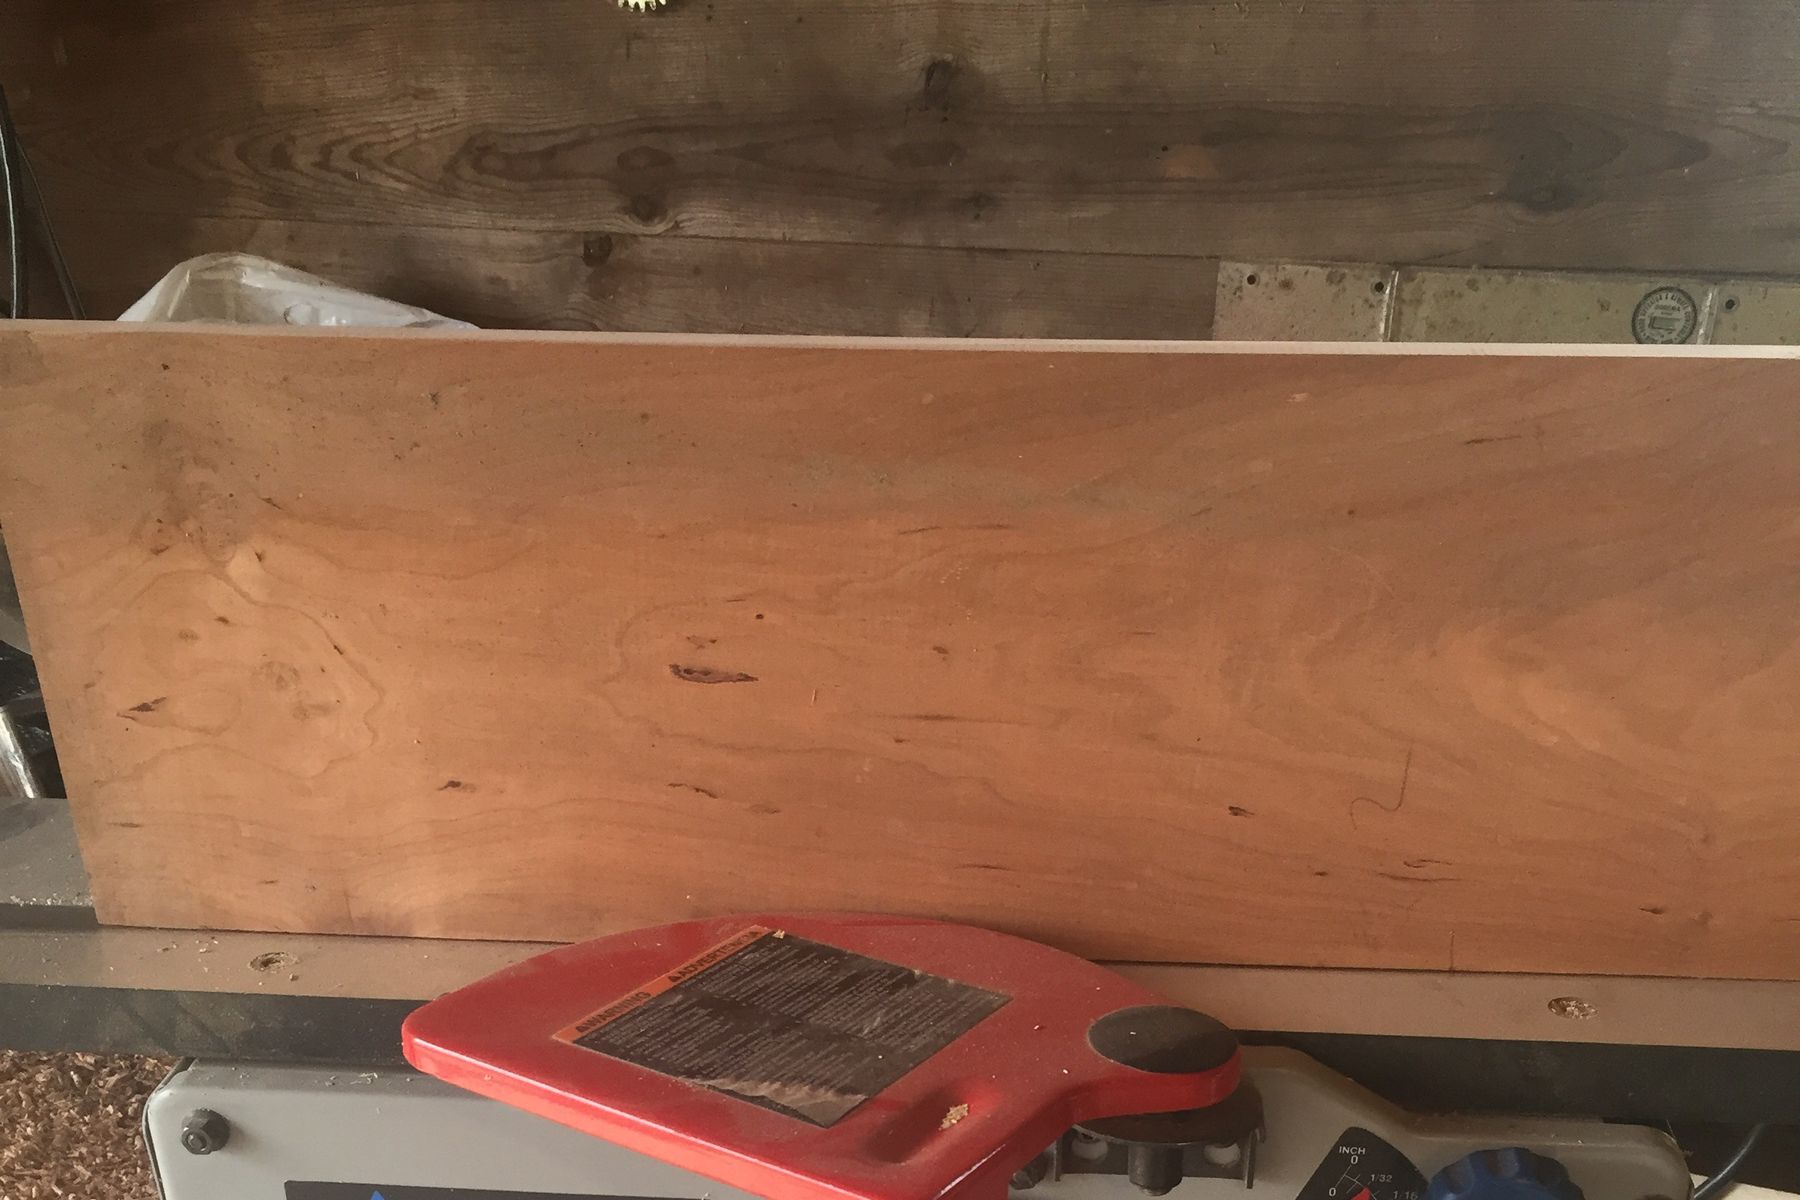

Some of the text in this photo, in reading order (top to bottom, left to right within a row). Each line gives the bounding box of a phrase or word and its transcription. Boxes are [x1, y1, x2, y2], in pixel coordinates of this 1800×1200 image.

[587, 991, 651, 1027] WARNING
[1339, 1146, 1366, 1155] INCH
[1350, 1155, 1358, 1165] 0
[1370, 1174, 1393, 1183] 1/32
[1329, 1187, 1337, 1197] 0
